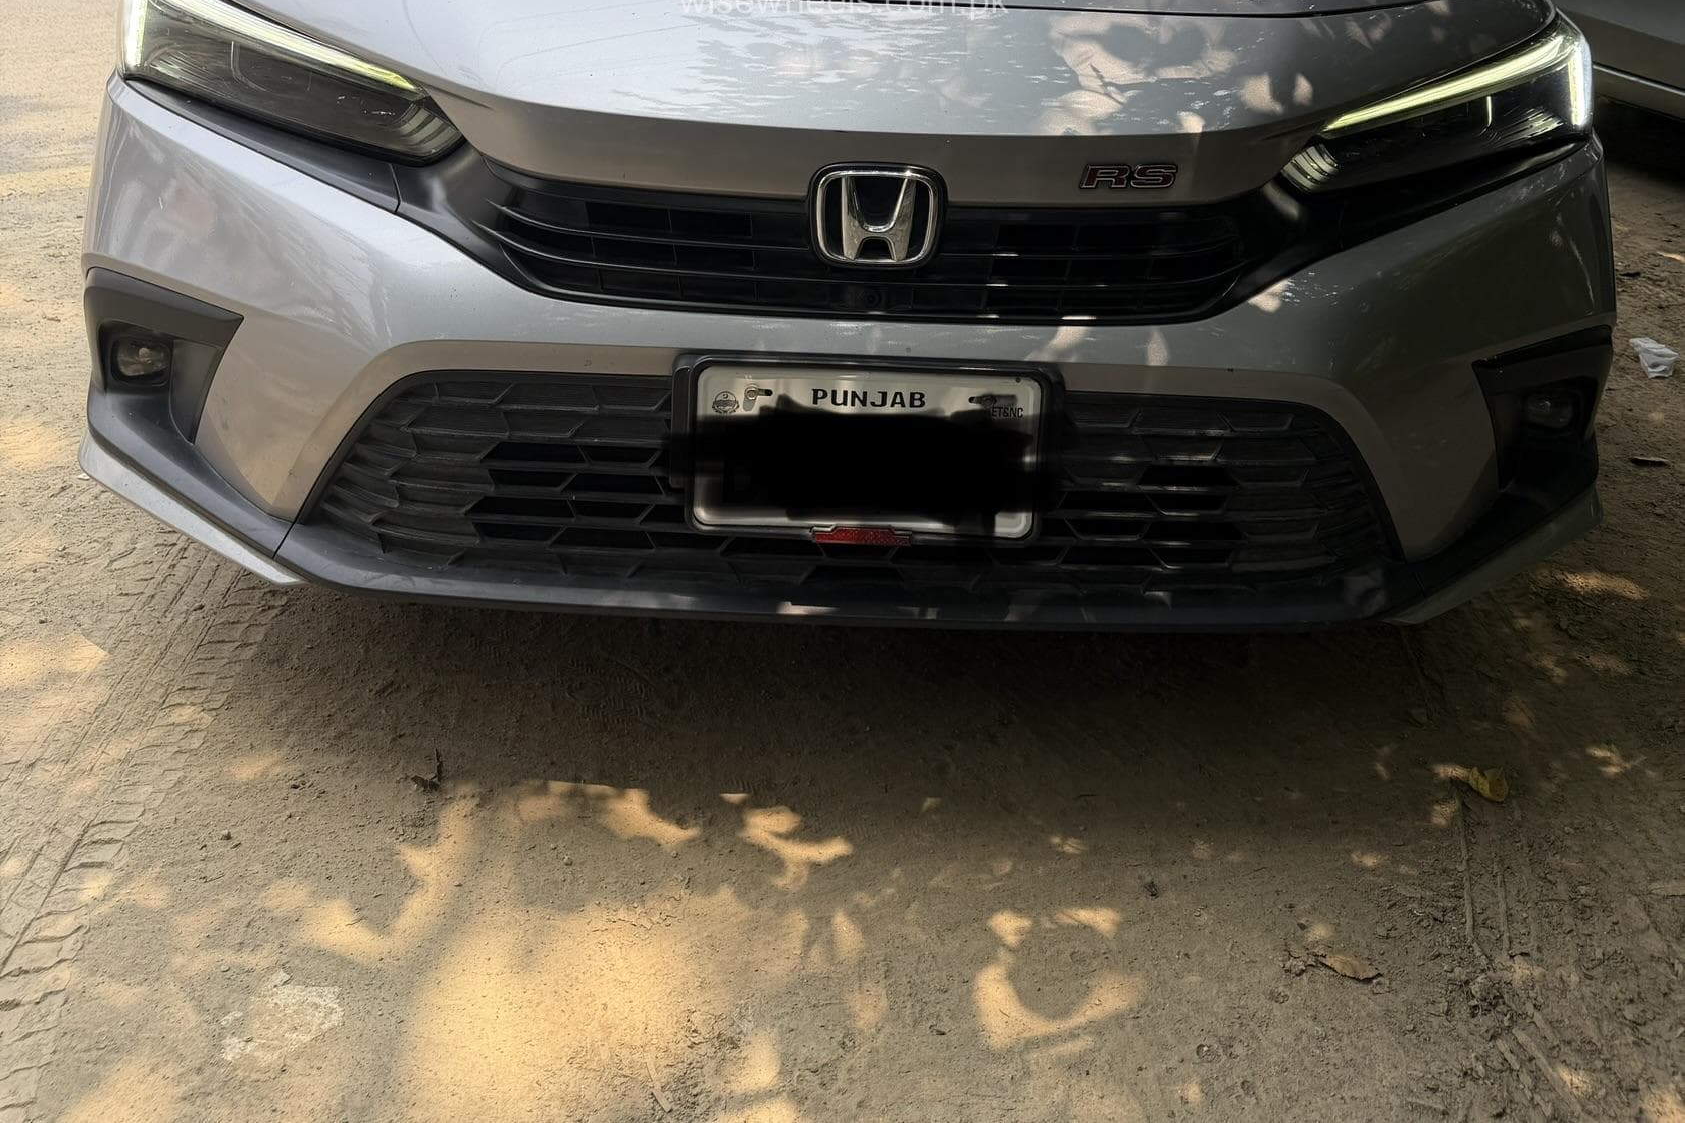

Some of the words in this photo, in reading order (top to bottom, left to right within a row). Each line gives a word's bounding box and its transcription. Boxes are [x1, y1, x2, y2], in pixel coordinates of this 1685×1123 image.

[1080, 163, 1177, 188] RS
[811, 388, 926, 408] PUNJAB
[991, 407, 1024, 419] ET&NC
